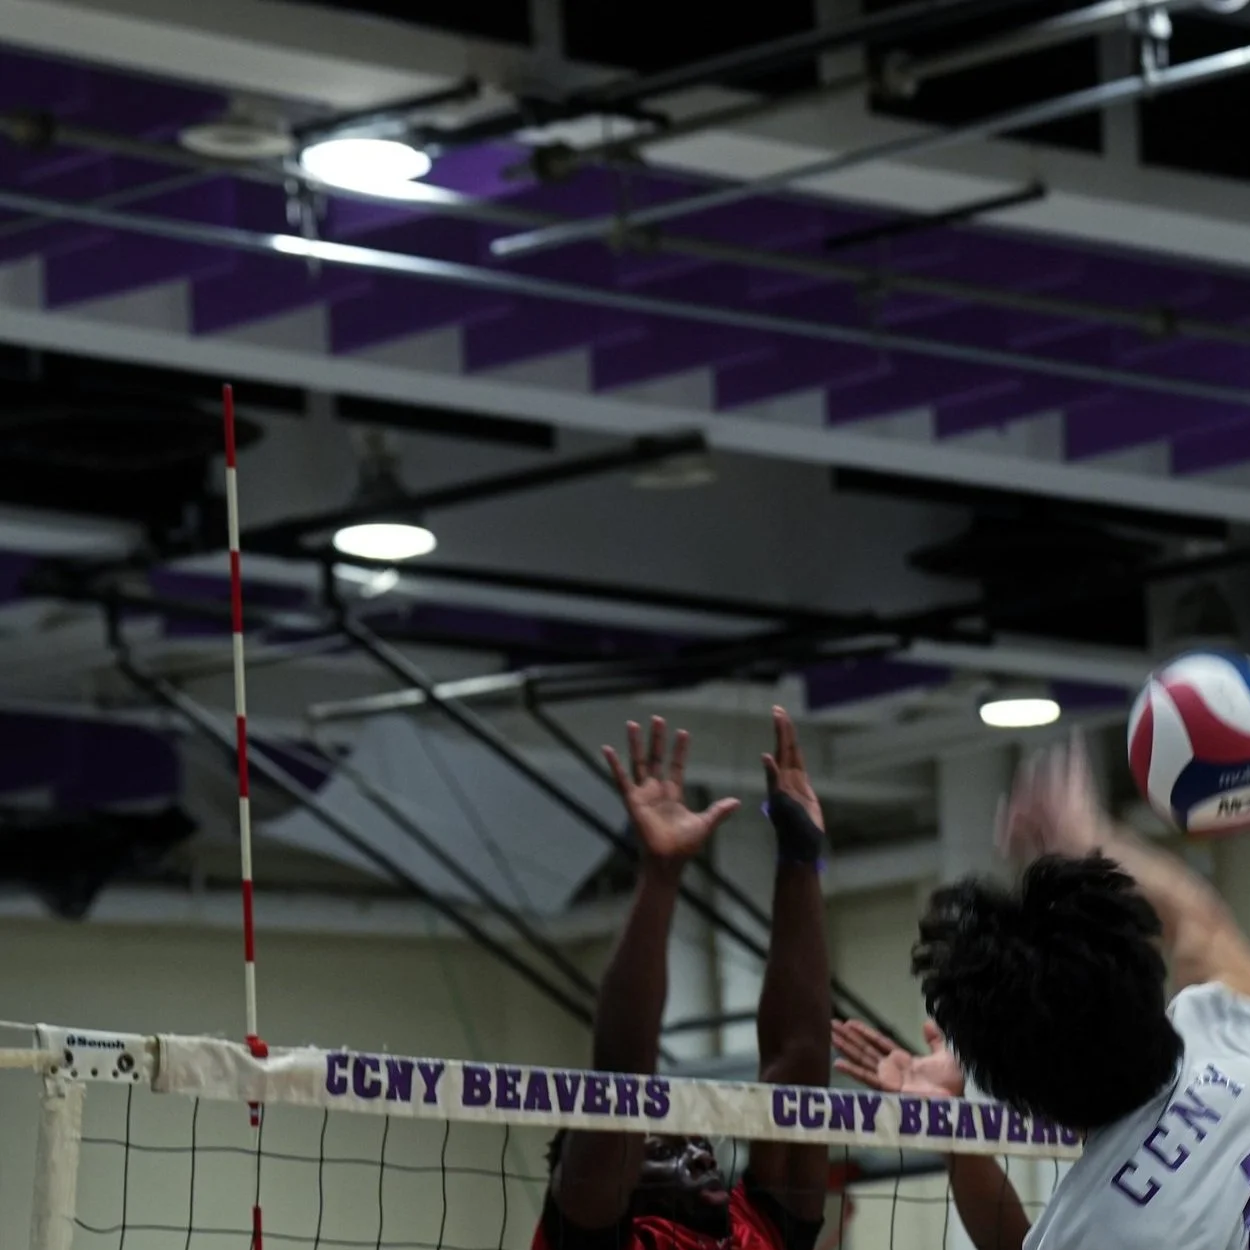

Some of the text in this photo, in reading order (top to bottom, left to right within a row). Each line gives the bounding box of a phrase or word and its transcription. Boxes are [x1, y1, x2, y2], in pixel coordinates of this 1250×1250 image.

[325, 1053, 671, 1119] CCNY BEAVERS
[772, 1088, 882, 1132] CCNY
[1110, 1062, 1244, 1208] CCNY
